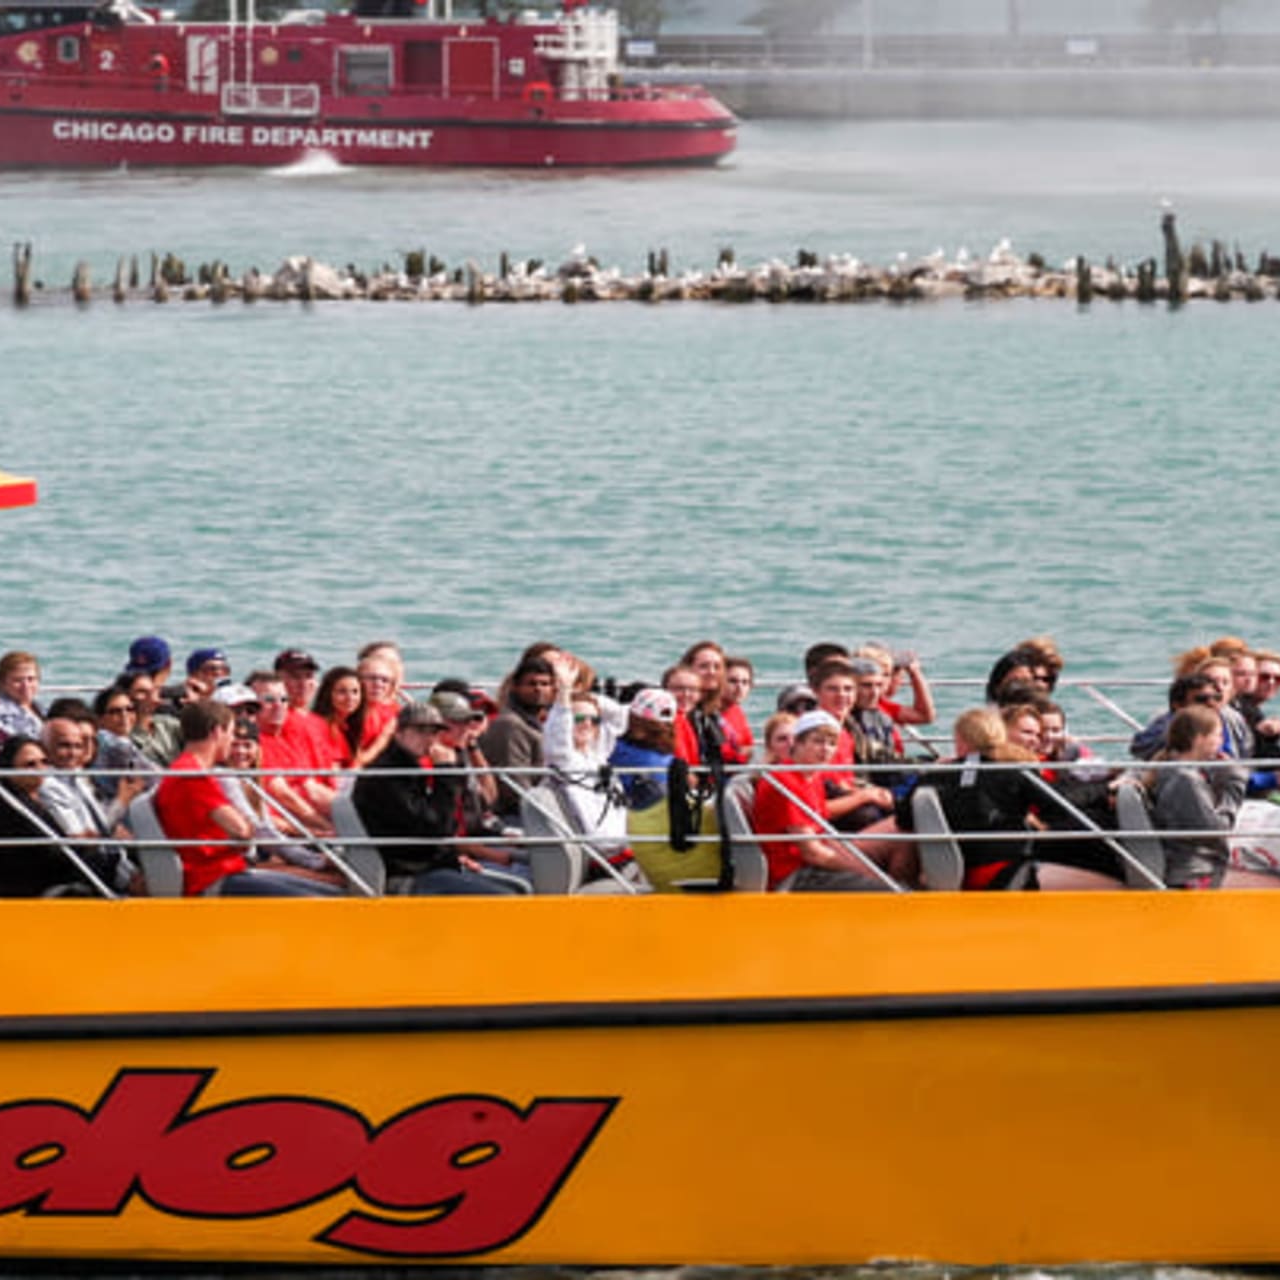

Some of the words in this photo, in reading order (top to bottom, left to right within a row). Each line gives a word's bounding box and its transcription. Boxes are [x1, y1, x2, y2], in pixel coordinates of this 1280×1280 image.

[99, 50, 115, 71] 2
[52, 120, 175, 142] CHICAGO
[183, 125, 243, 144] FIRE
[252, 126, 433, 148] DEPARTMENT
